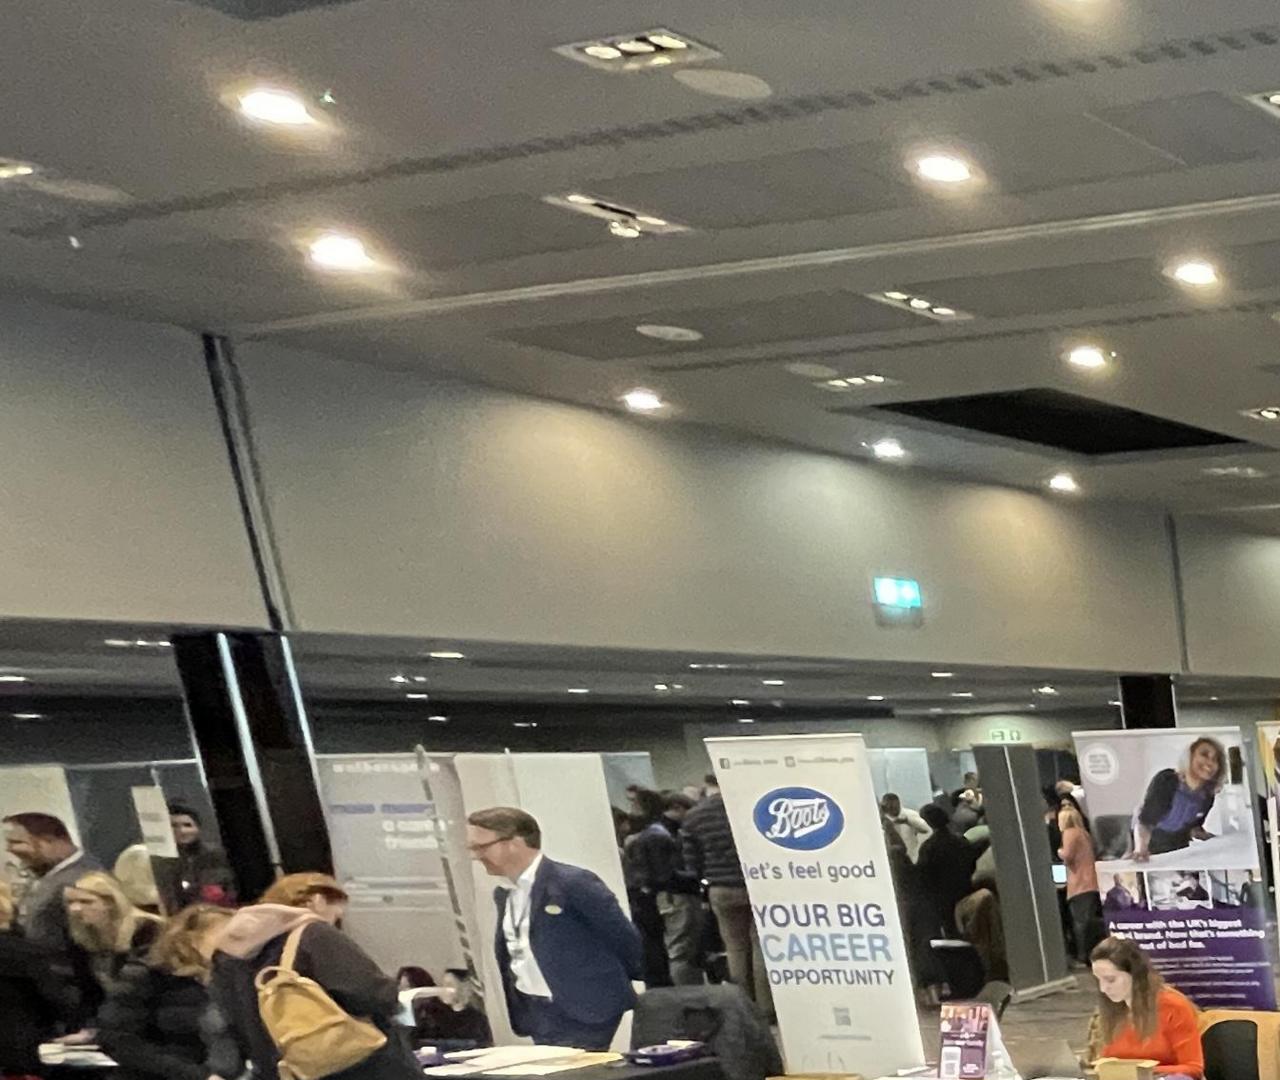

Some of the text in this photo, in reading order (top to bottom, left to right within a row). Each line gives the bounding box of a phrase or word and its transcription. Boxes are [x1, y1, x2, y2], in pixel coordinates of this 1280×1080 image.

[765, 797, 830, 839] Boots
[743, 860, 876, 883] let's feel good
[753, 903, 885, 928] YOUR BIG
[763, 933, 893, 962] CAREER
[769, 969, 895, 986] OPPORTUNITY
